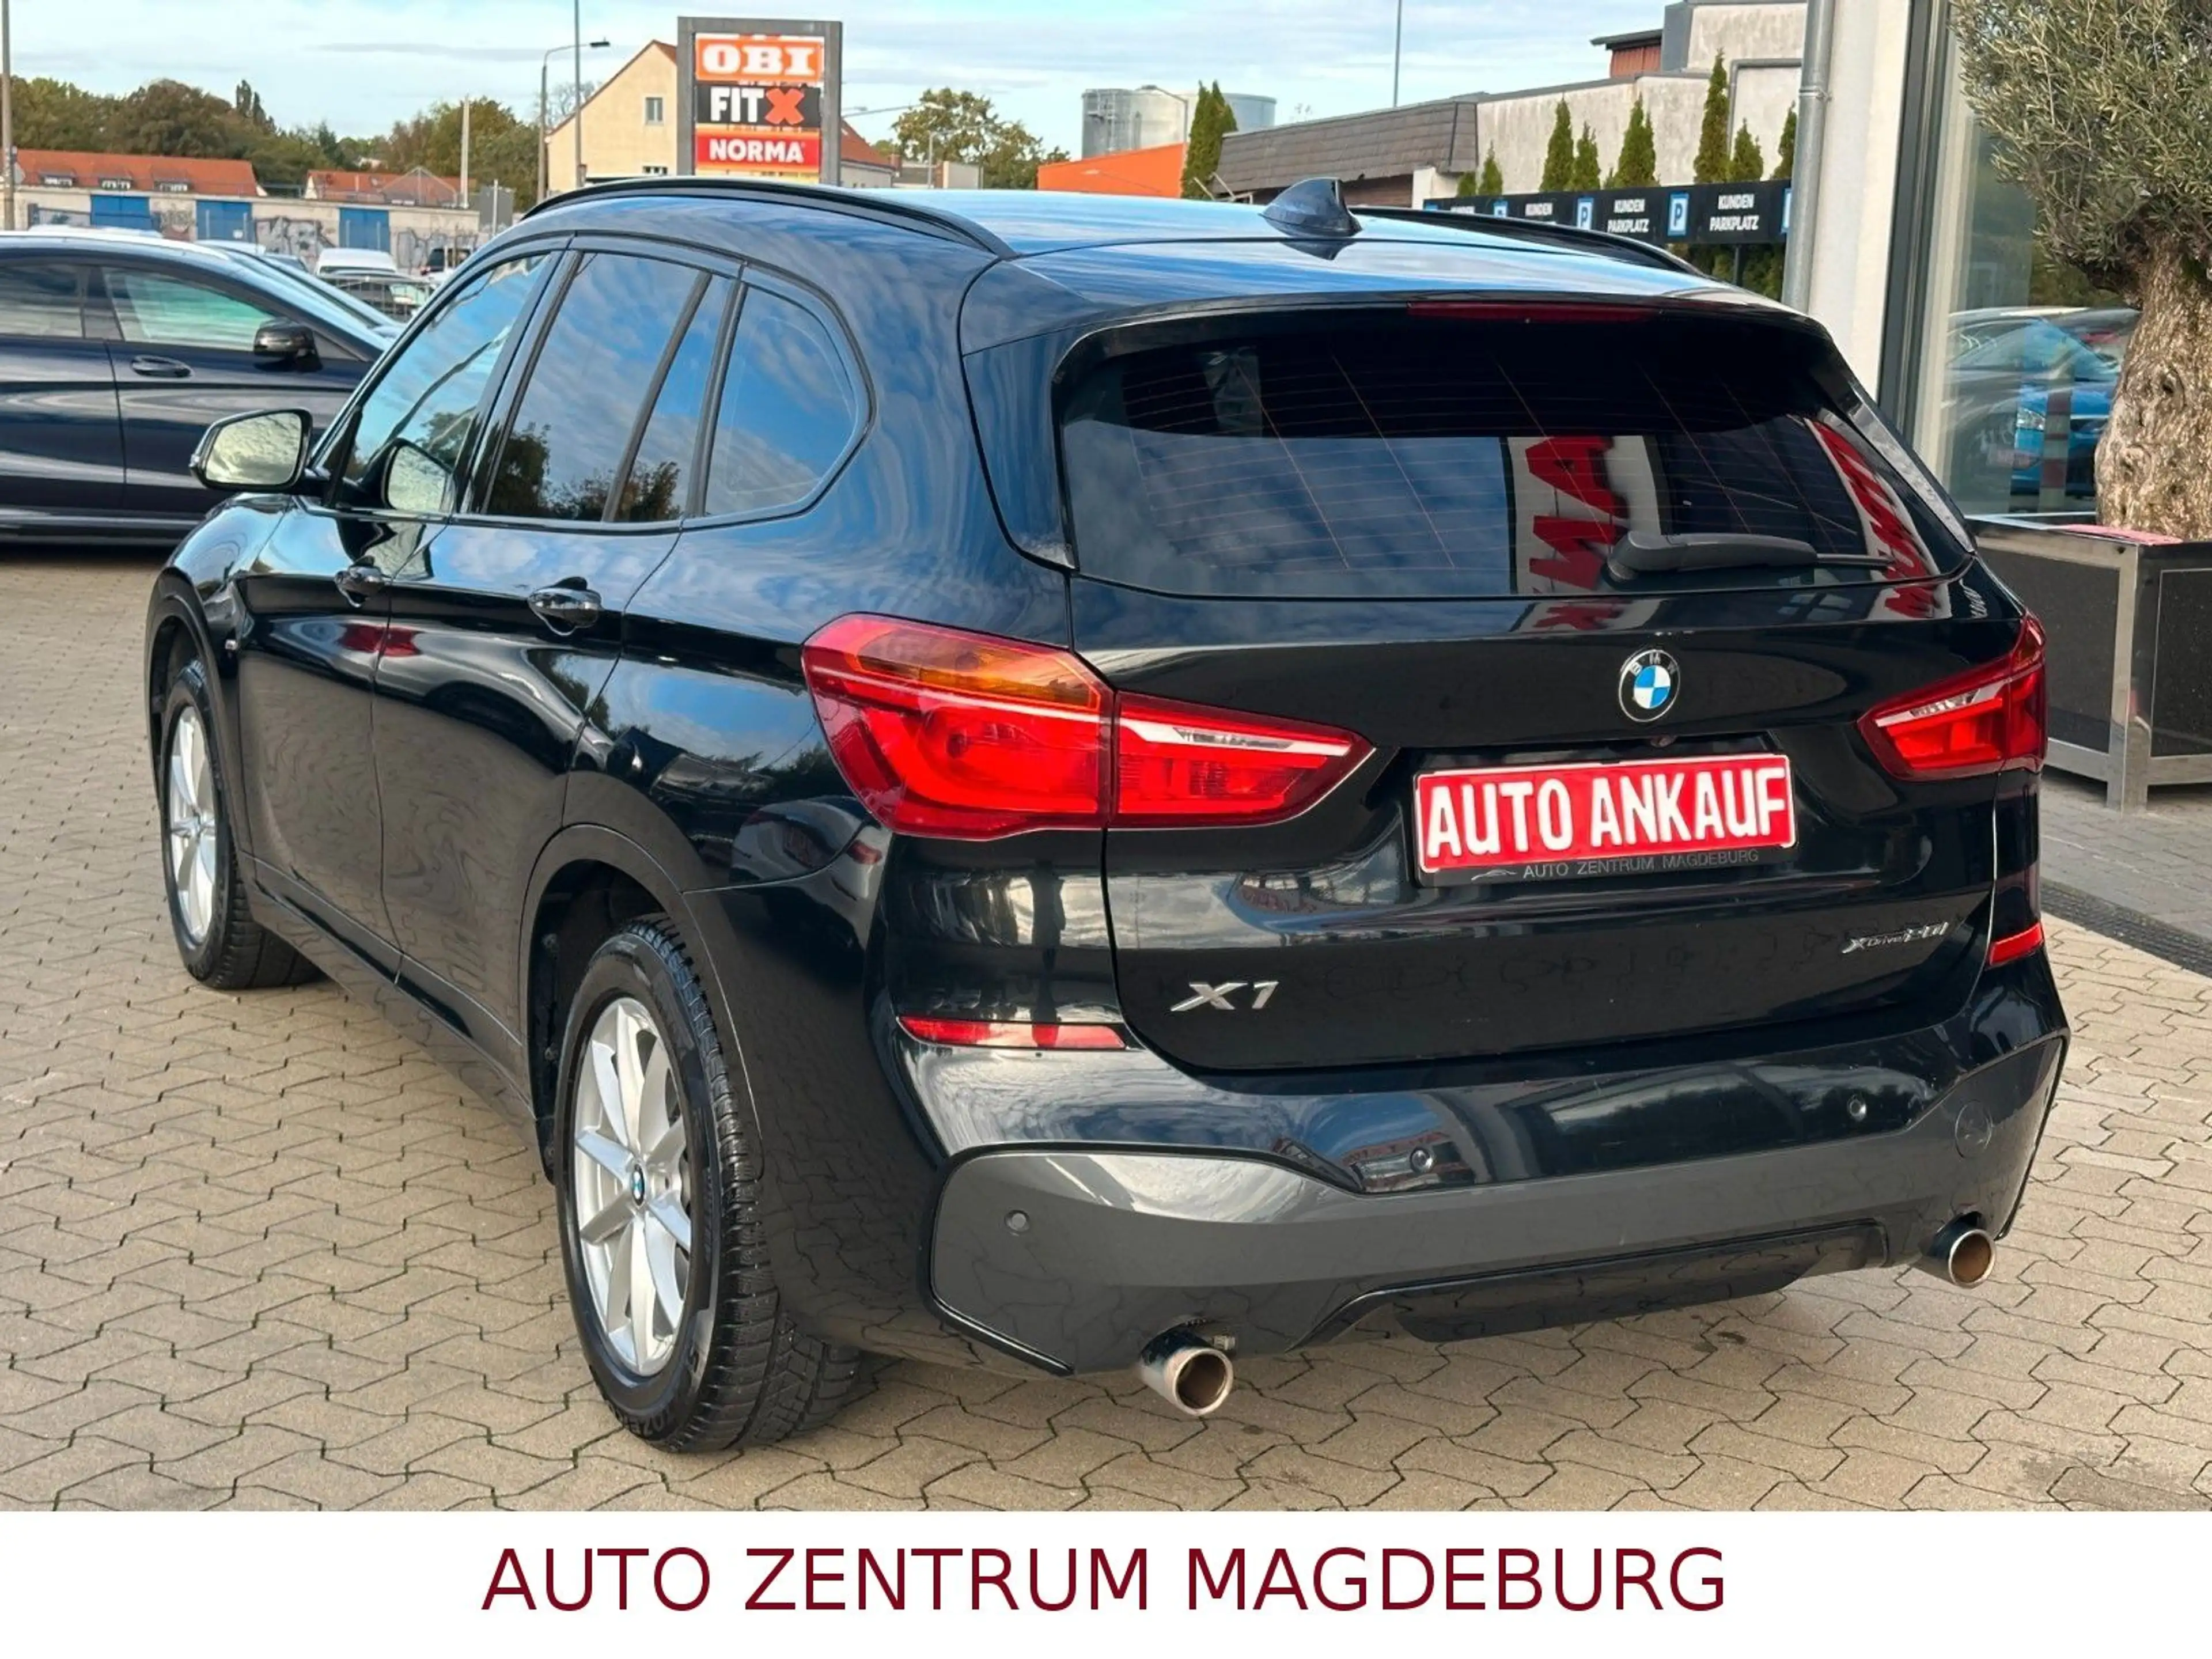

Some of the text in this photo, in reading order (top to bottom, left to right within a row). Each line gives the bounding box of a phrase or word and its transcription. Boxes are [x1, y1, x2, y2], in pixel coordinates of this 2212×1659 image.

[702, 44, 816, 75] OBI
[709, 139, 804, 163] NORMA
[1613, 198, 1645, 214] KUNDEN
[1718, 194, 1755, 210] KUNDEN
[1607, 217, 1649, 233] PARKPLATZ
[1709, 215, 1760, 232] PARKPLATZ
[1427, 767, 1785, 858] AUTO ANKAUF
[1523, 849, 1759, 879] AUTO ZENTRUM MAGDEBURG
[1171, 981, 1279, 1012] X1
